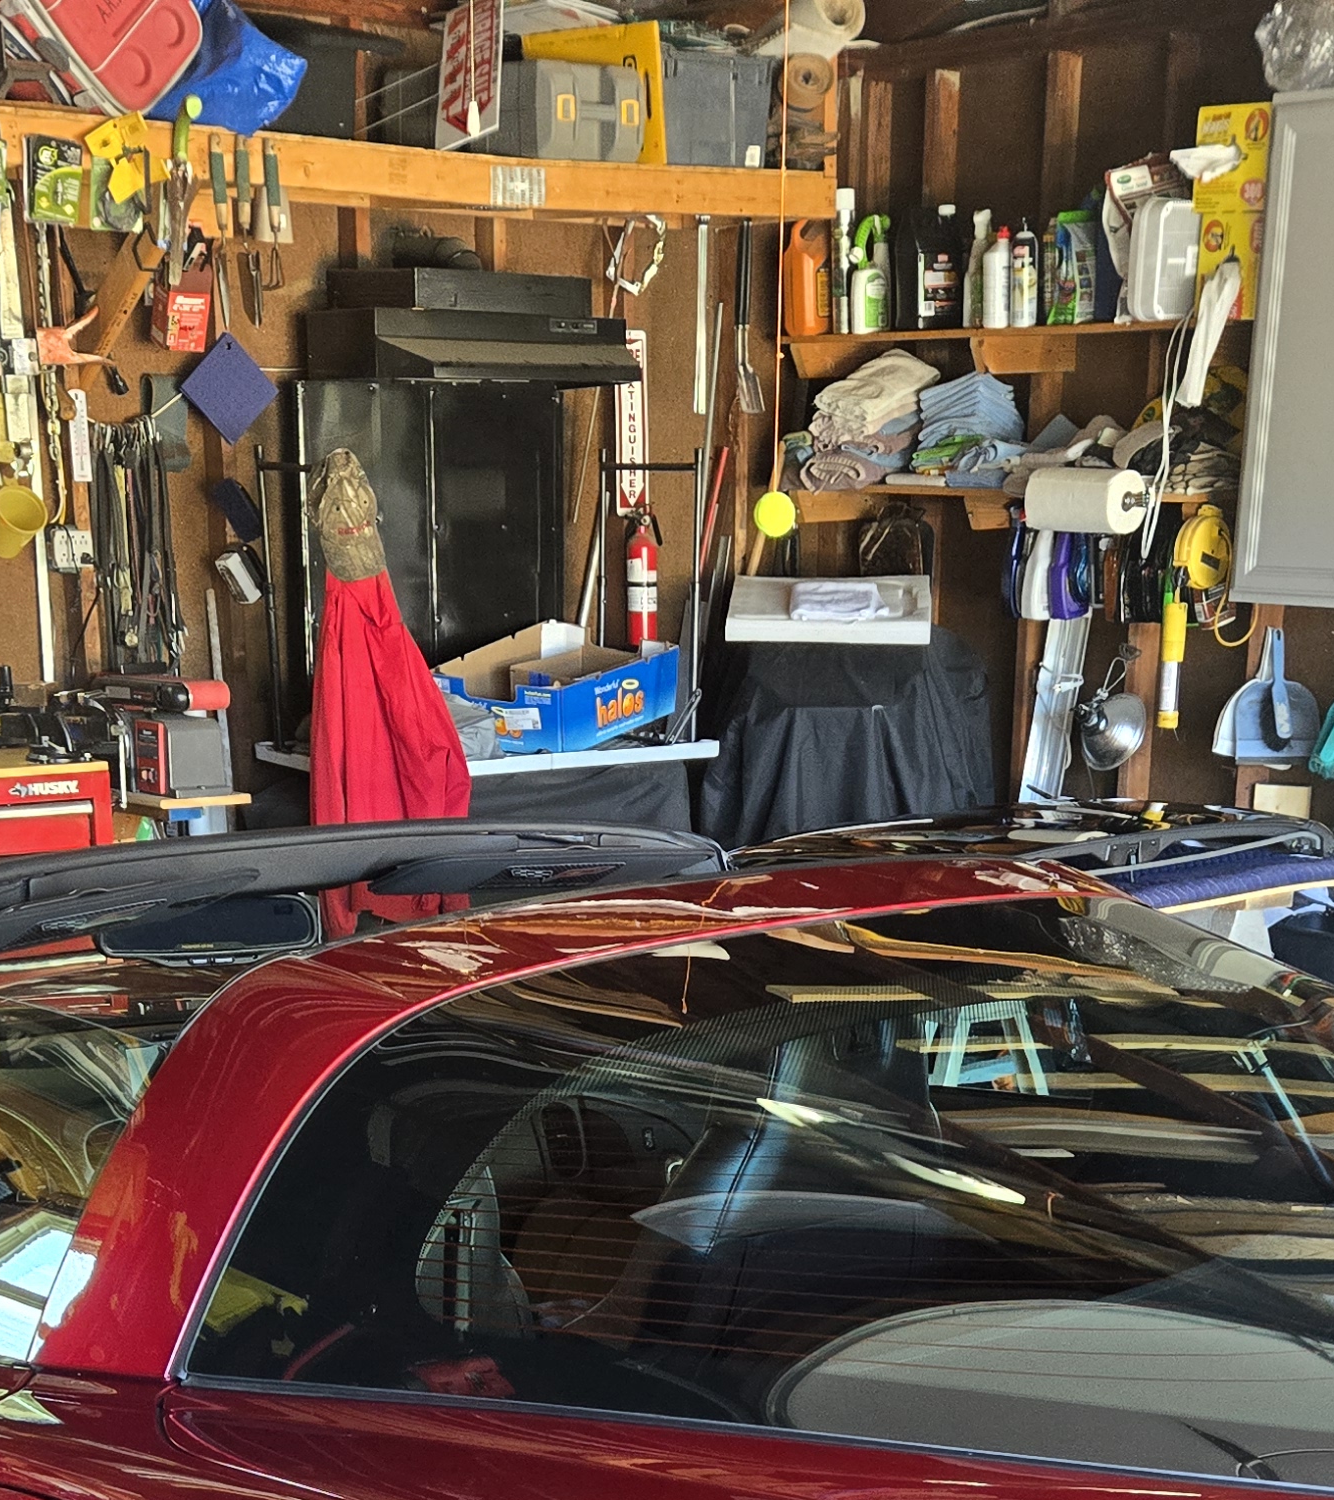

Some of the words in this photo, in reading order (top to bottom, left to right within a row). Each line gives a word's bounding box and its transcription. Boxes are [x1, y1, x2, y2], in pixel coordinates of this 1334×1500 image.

[627, 382, 637, 499] XTINGUISHER
[595, 688, 645, 729] halos
[27, 780, 79, 796] HUSKY
